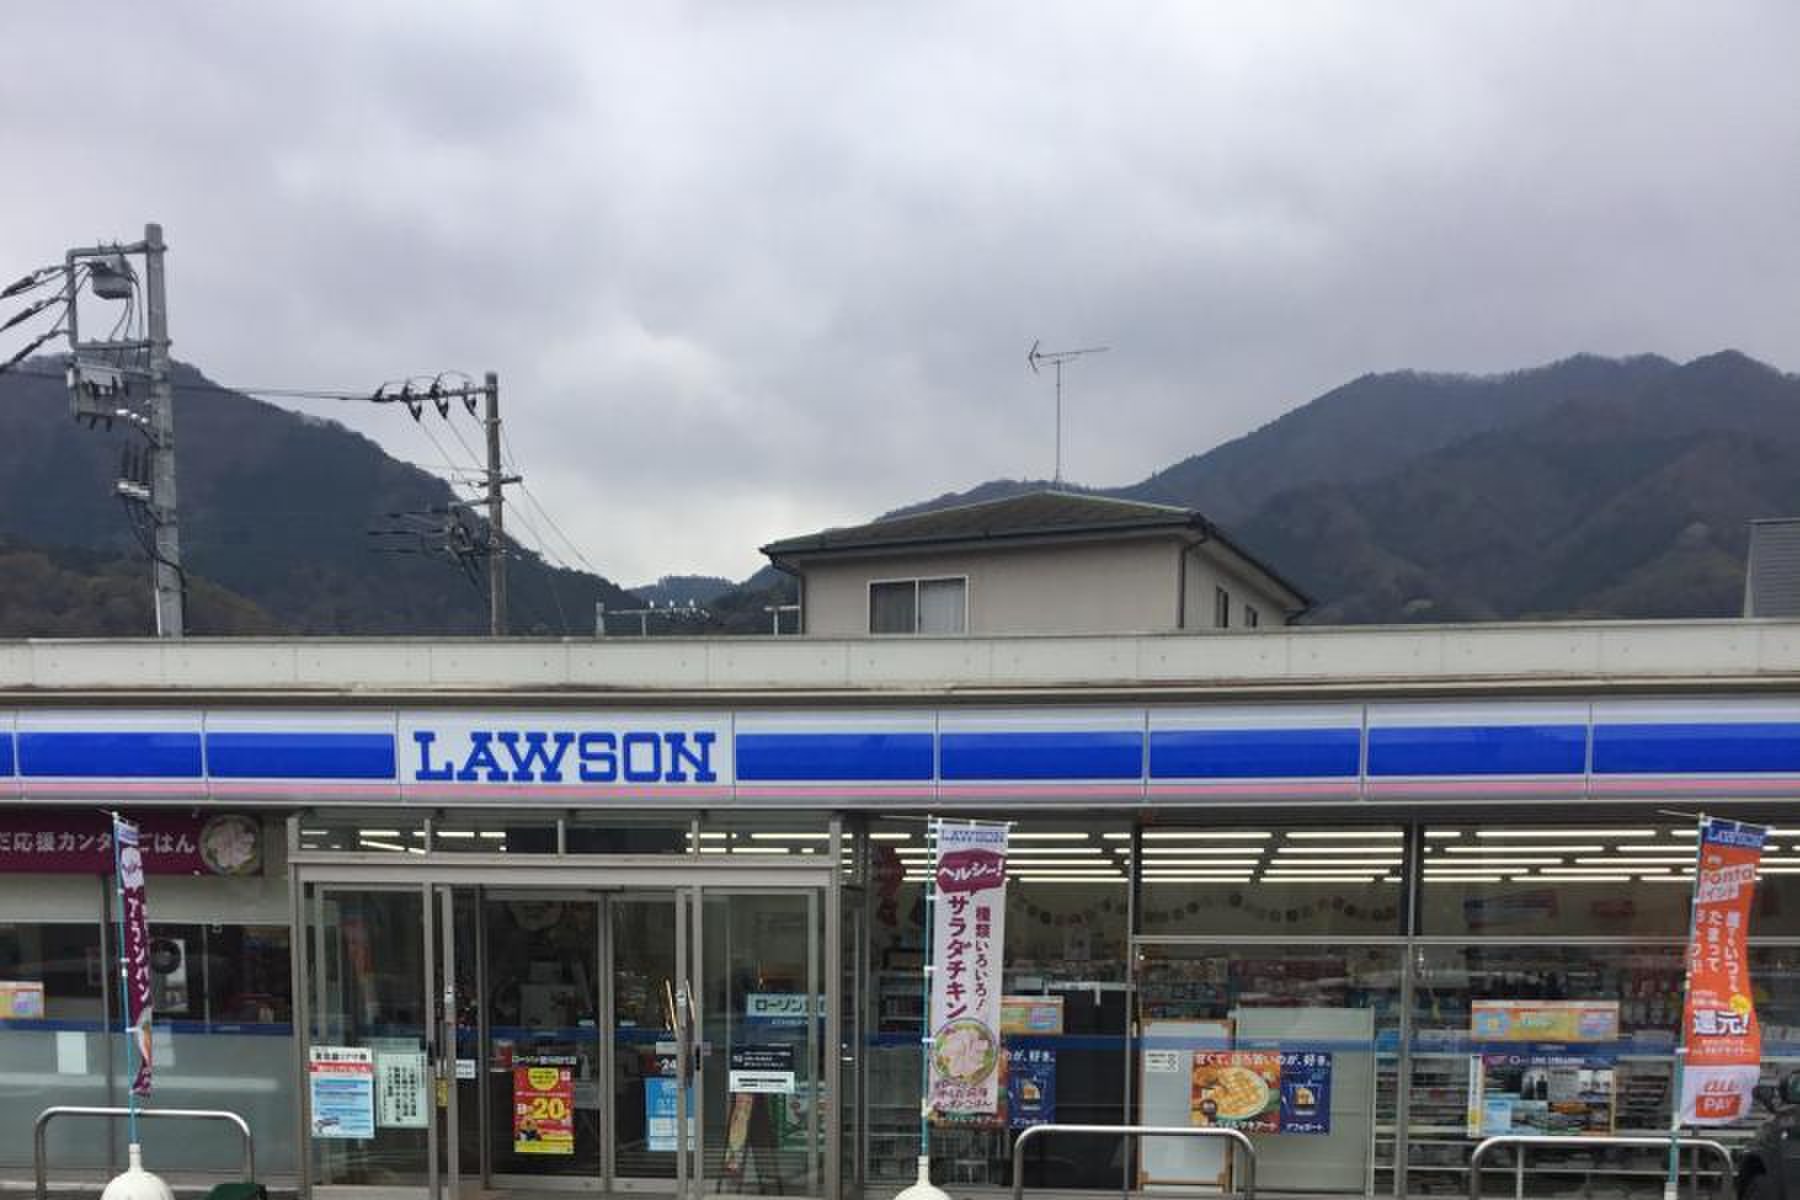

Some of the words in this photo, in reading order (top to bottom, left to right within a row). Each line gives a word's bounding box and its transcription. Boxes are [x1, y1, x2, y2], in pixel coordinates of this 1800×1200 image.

[413, 731, 717, 783] LAWSON
[945, 895, 972, 1019] サラダチキン
